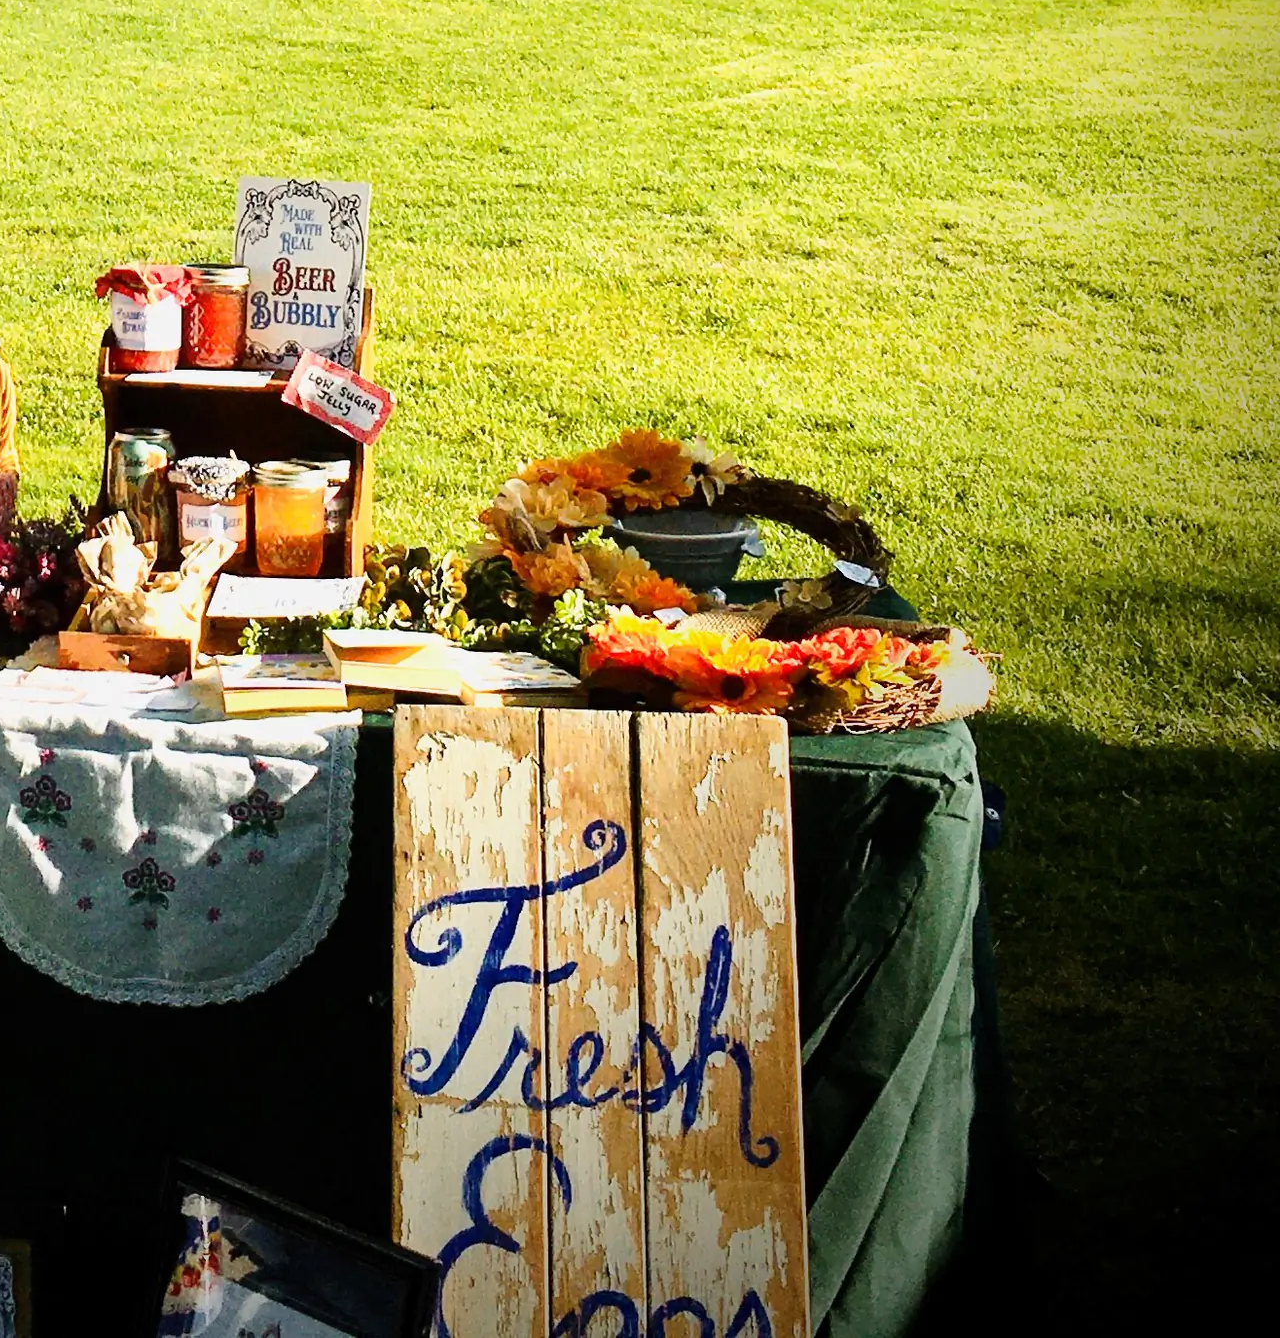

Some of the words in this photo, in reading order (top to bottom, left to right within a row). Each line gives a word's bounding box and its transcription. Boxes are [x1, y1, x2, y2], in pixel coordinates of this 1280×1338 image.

[280, 204, 315, 225] MADE
[294, 223, 322, 237] WITH
[278, 232, 314, 255] REAL
[272, 257, 337, 296] BEER
[250, 291, 342, 330] BUBBLY
[308, 372, 335, 390] LOW
[338, 386, 377, 415] SUGAR
[317, 389, 351, 417] JELLY
[401, 819, 779, 1167] Fresh
